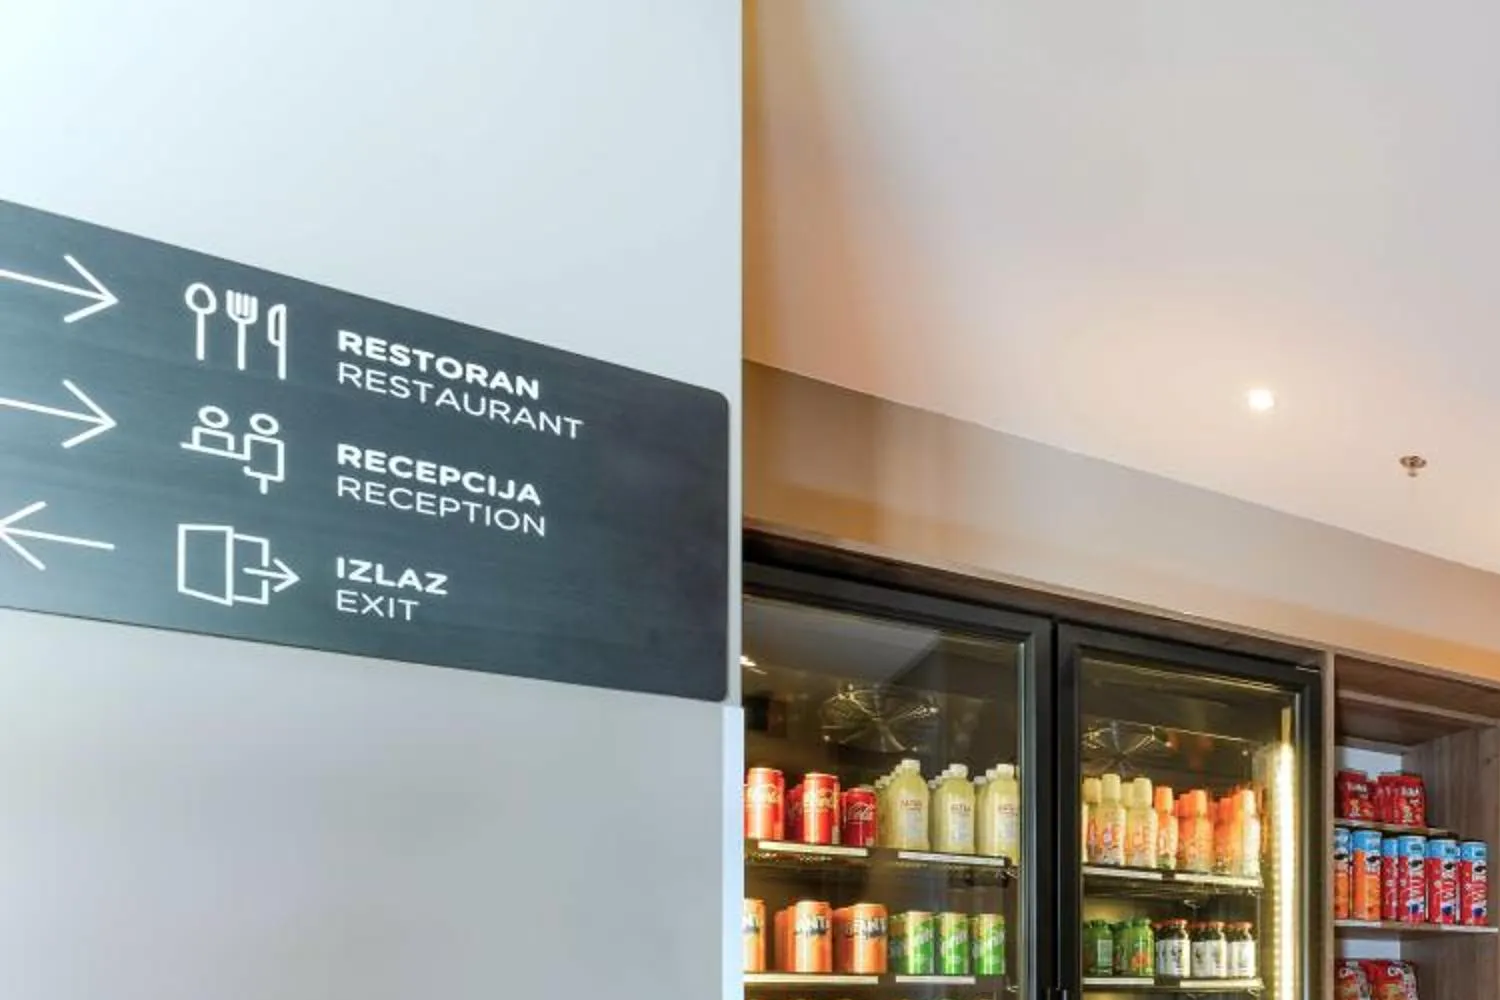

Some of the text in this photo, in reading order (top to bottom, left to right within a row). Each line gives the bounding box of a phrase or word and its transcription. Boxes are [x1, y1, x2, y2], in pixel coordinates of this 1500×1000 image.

[338, 329, 540, 400] RESTORAN
[338, 361, 584, 439] RESTAURANT
[337, 443, 541, 506] RECEPCIJA
[337, 475, 545, 537] RECEPTION
[336, 556, 448, 595] IZLAZ
[336, 589, 419, 621] EXIT
